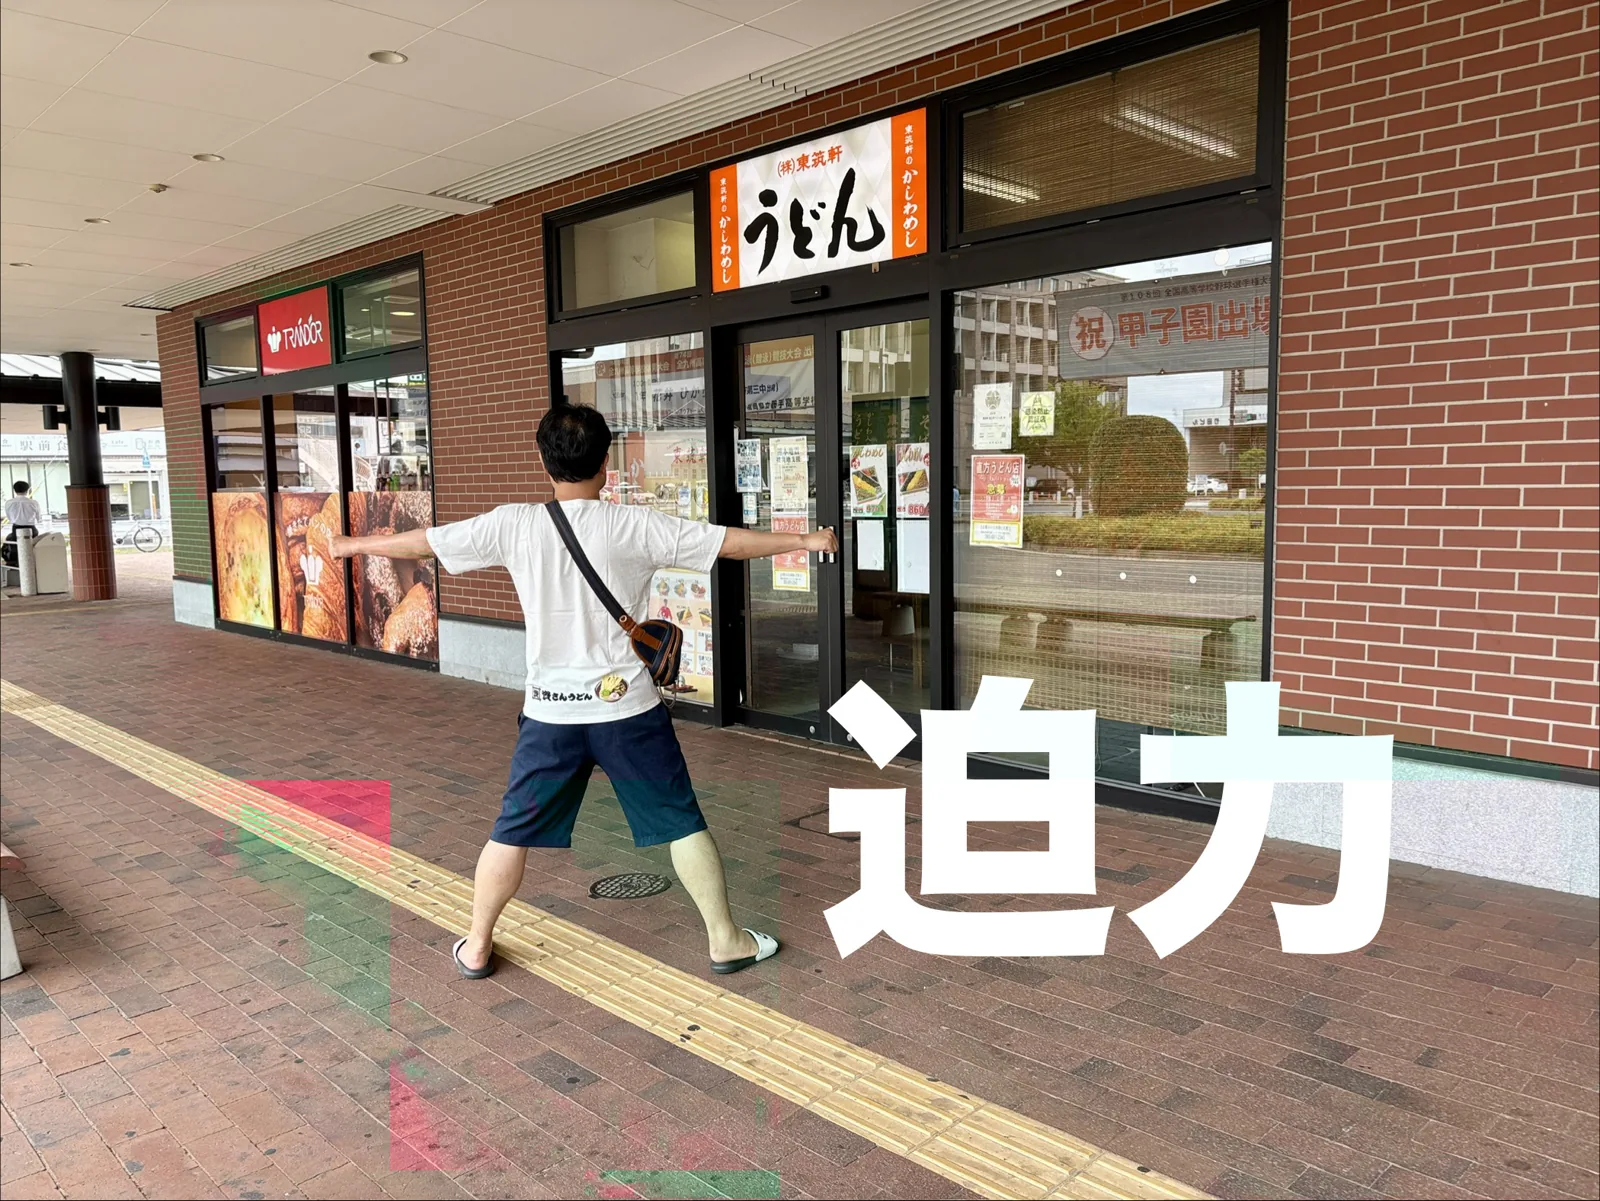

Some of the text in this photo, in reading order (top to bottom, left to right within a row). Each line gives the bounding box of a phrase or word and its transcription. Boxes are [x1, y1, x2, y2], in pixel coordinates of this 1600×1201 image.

[777, 145, 844, 178] (株)東筑軒
[902, 124, 919, 249] 東筑軒のかしわめし
[718, 177, 733, 285] 東筑軒のかしわめし
[743, 167, 886, 276] うどん
[1075, 316, 1107, 352] 祝
[854, 414, 863, 445] うど
[865, 412, 874, 443] かしわ入
[20, 439, 68, 452] 駅前食
[976, 461, 1020, 475] 直方うどん店
